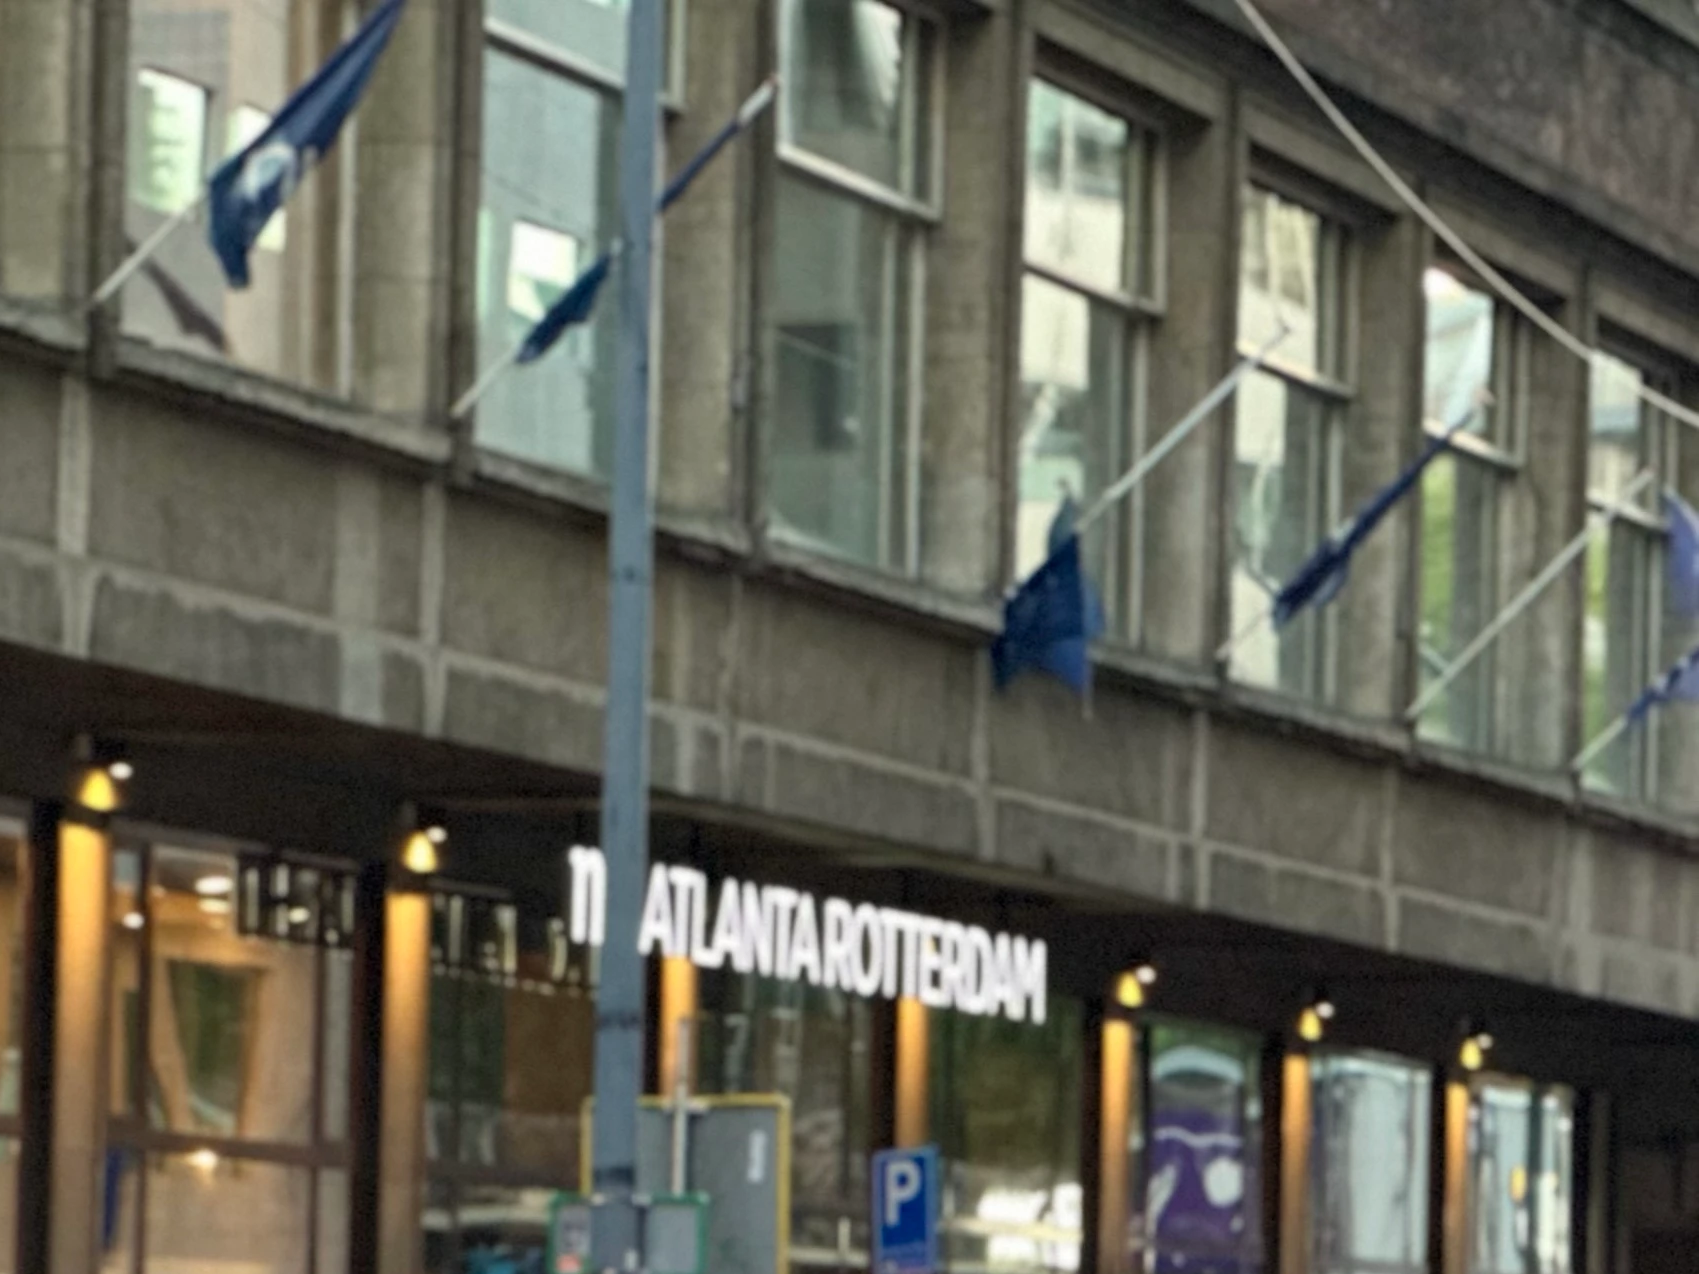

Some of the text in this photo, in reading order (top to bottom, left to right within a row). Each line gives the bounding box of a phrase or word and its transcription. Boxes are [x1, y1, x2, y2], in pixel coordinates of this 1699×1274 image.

[636, 860, 821, 986] ATLANTA
[822, 896, 1048, 1026] ROTTERDAM
[885, 1160, 921, 1227] P
